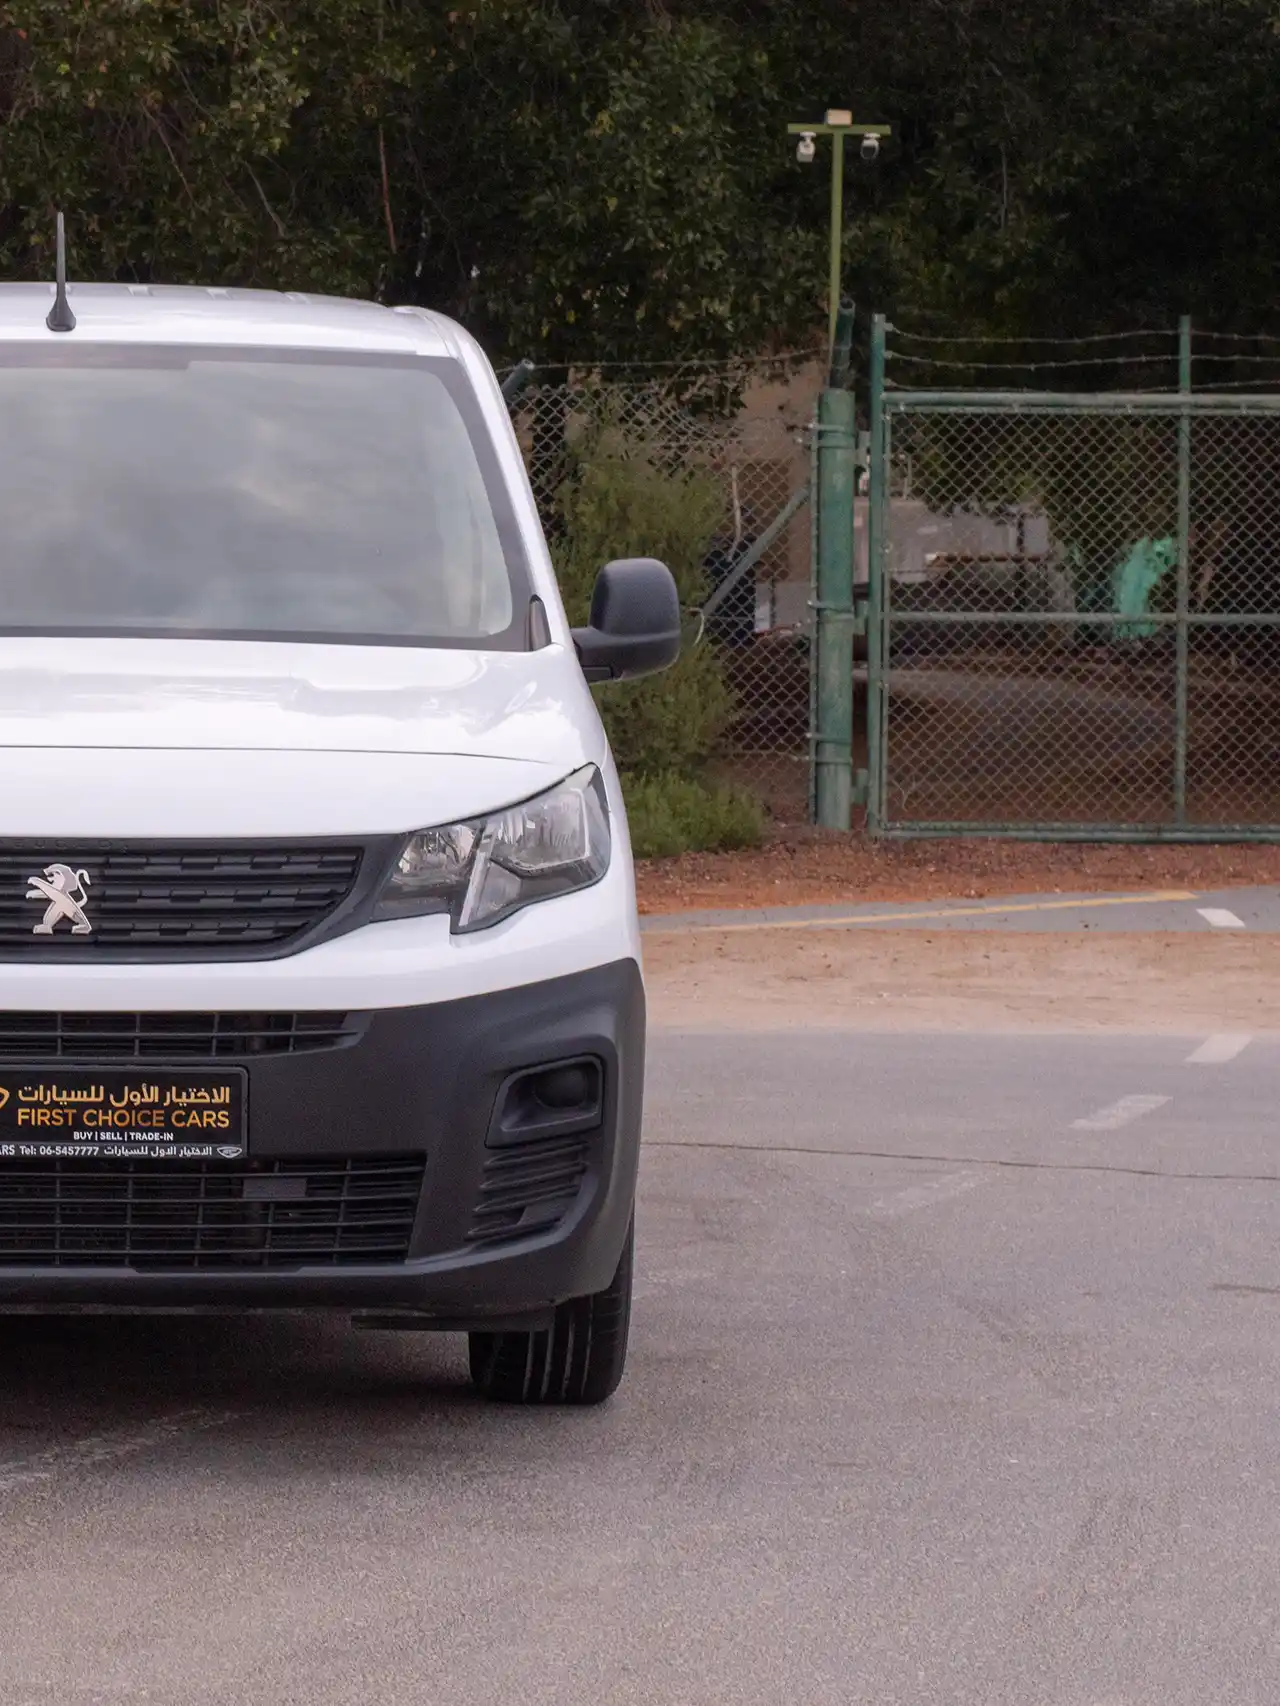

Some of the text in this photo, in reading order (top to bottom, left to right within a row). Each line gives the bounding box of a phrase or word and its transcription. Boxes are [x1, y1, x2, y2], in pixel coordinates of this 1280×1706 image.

[18, 1083, 231, 1108] الاختيار الأول للسيارات
[17, 1108, 230, 1129] FIRST CHOICE CARS
[73, 1131, 93, 1141] BUY
[100, 1131, 123, 1142] SELL
[130, 1132, 174, 1142] TRADE-IN
[19, 1145, 37, 1156] Tel:
[39, 1145, 100, 1157] 06-5457777
[178, 1145, 213, 1158] الاختيار
